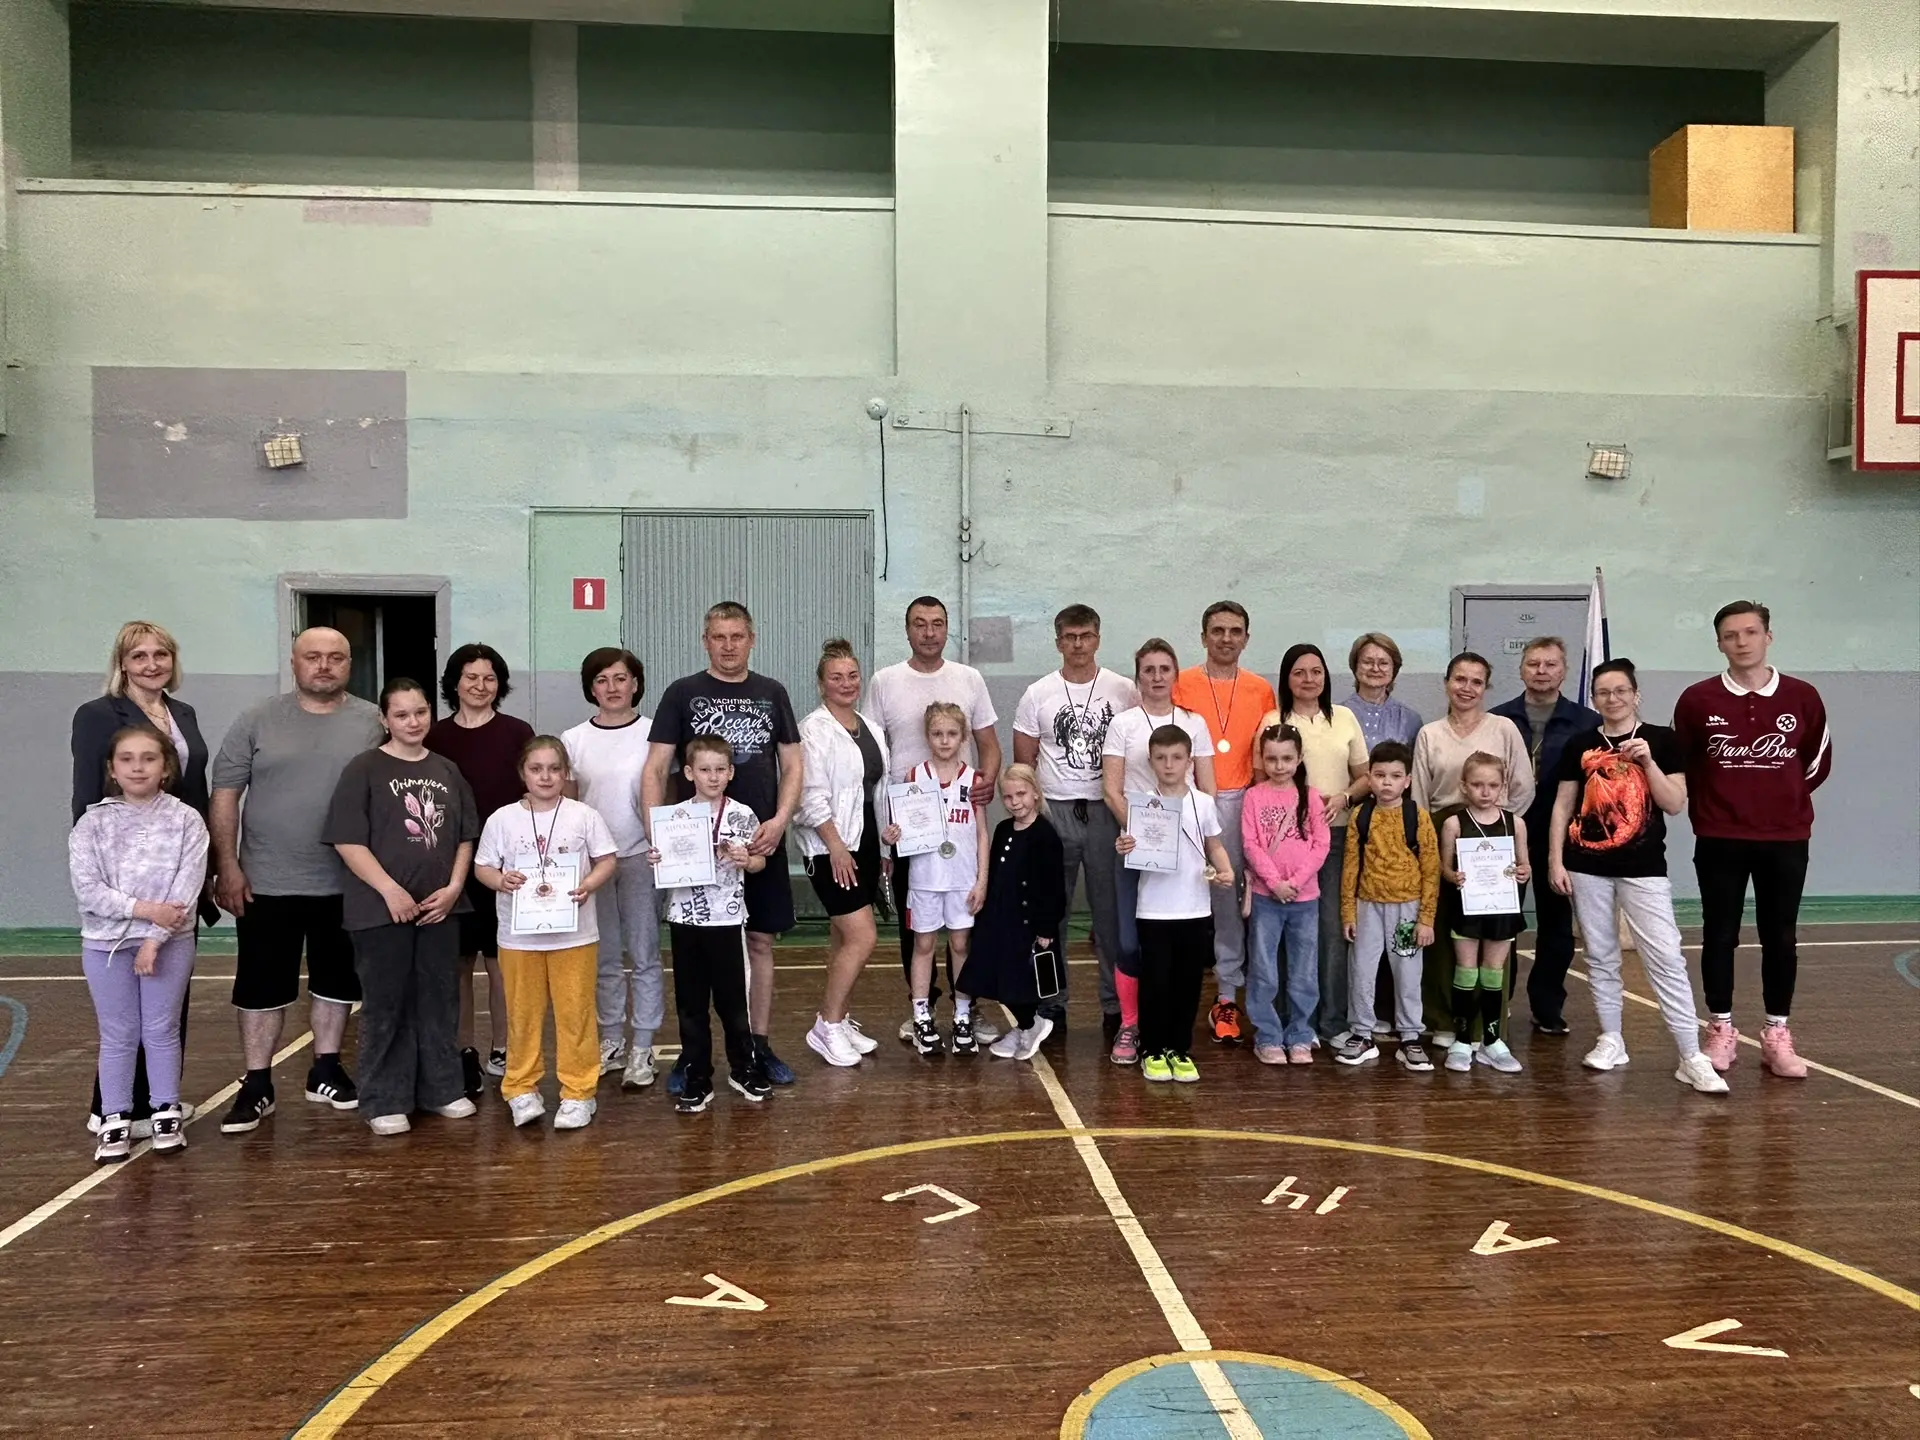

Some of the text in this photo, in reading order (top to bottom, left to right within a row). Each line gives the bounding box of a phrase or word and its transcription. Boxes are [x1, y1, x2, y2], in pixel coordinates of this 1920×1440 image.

[690, 704, 774, 730] ATLANTIC SAILING
[709, 711, 763, 732] Ocean
[389, 778, 449, 796] Primavera
